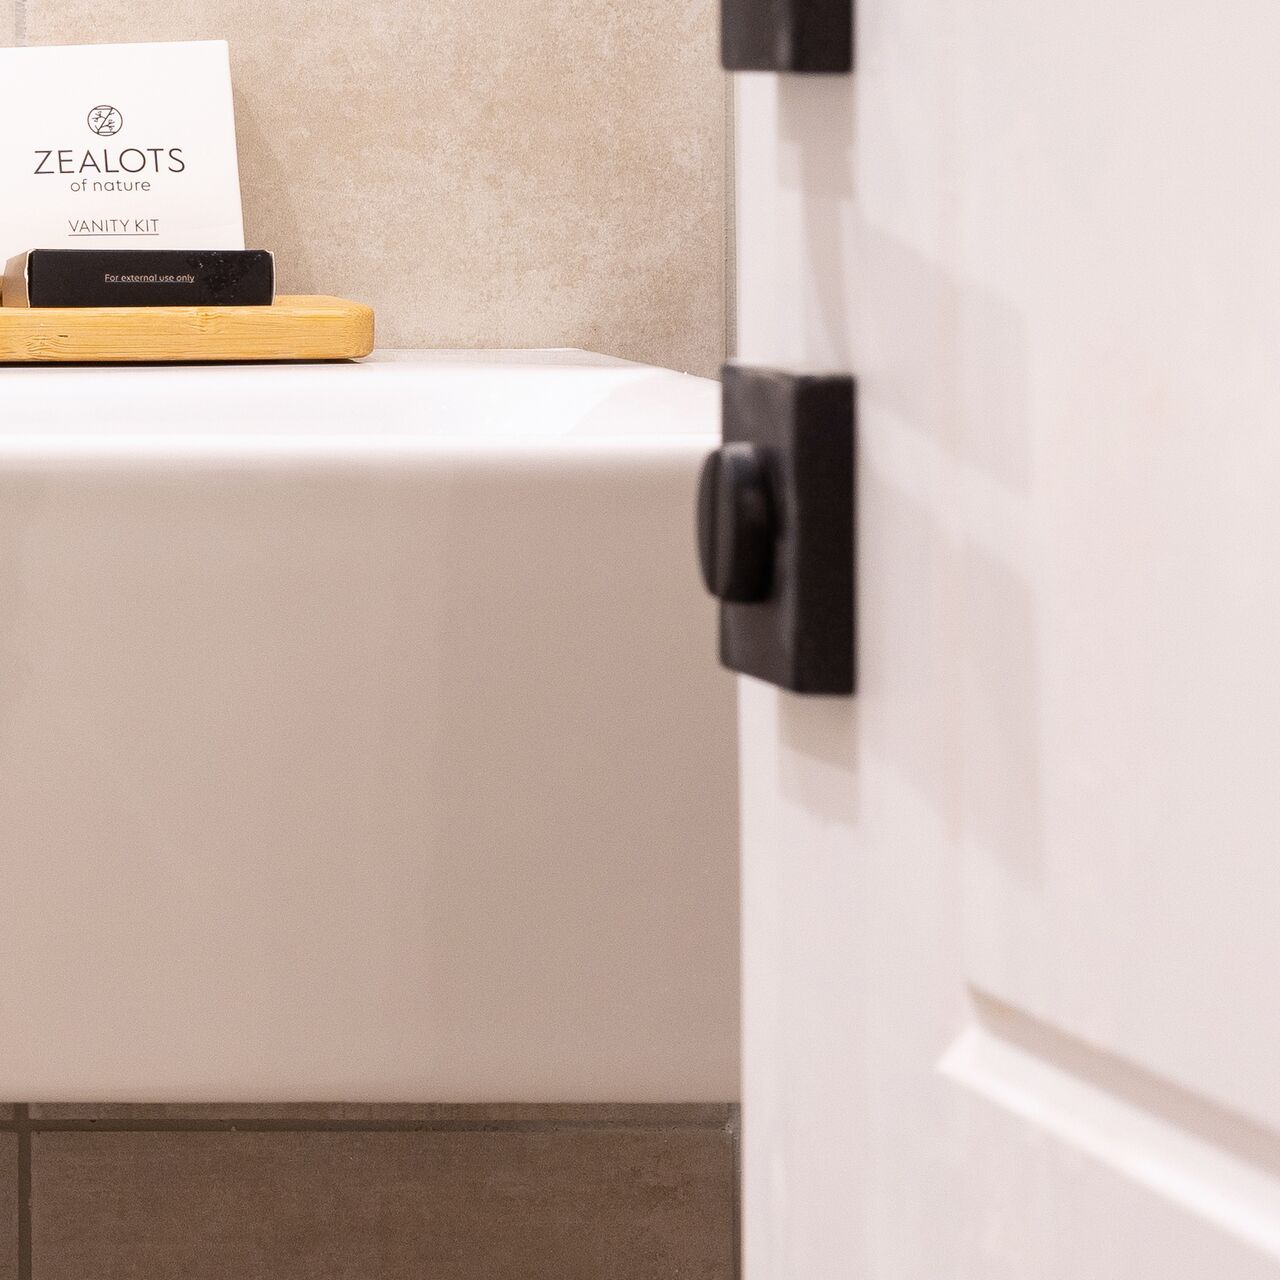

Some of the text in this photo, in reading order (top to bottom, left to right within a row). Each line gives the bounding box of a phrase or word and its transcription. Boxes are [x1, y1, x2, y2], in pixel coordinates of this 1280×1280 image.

[33, 148, 185, 175] ZEALOTS
[70, 179, 151, 192] of nature
[68, 219, 159, 233] VANITY KIT
[105, 273, 119, 283] For
[121, 273, 157, 282] external
[176, 273, 195, 283] only
